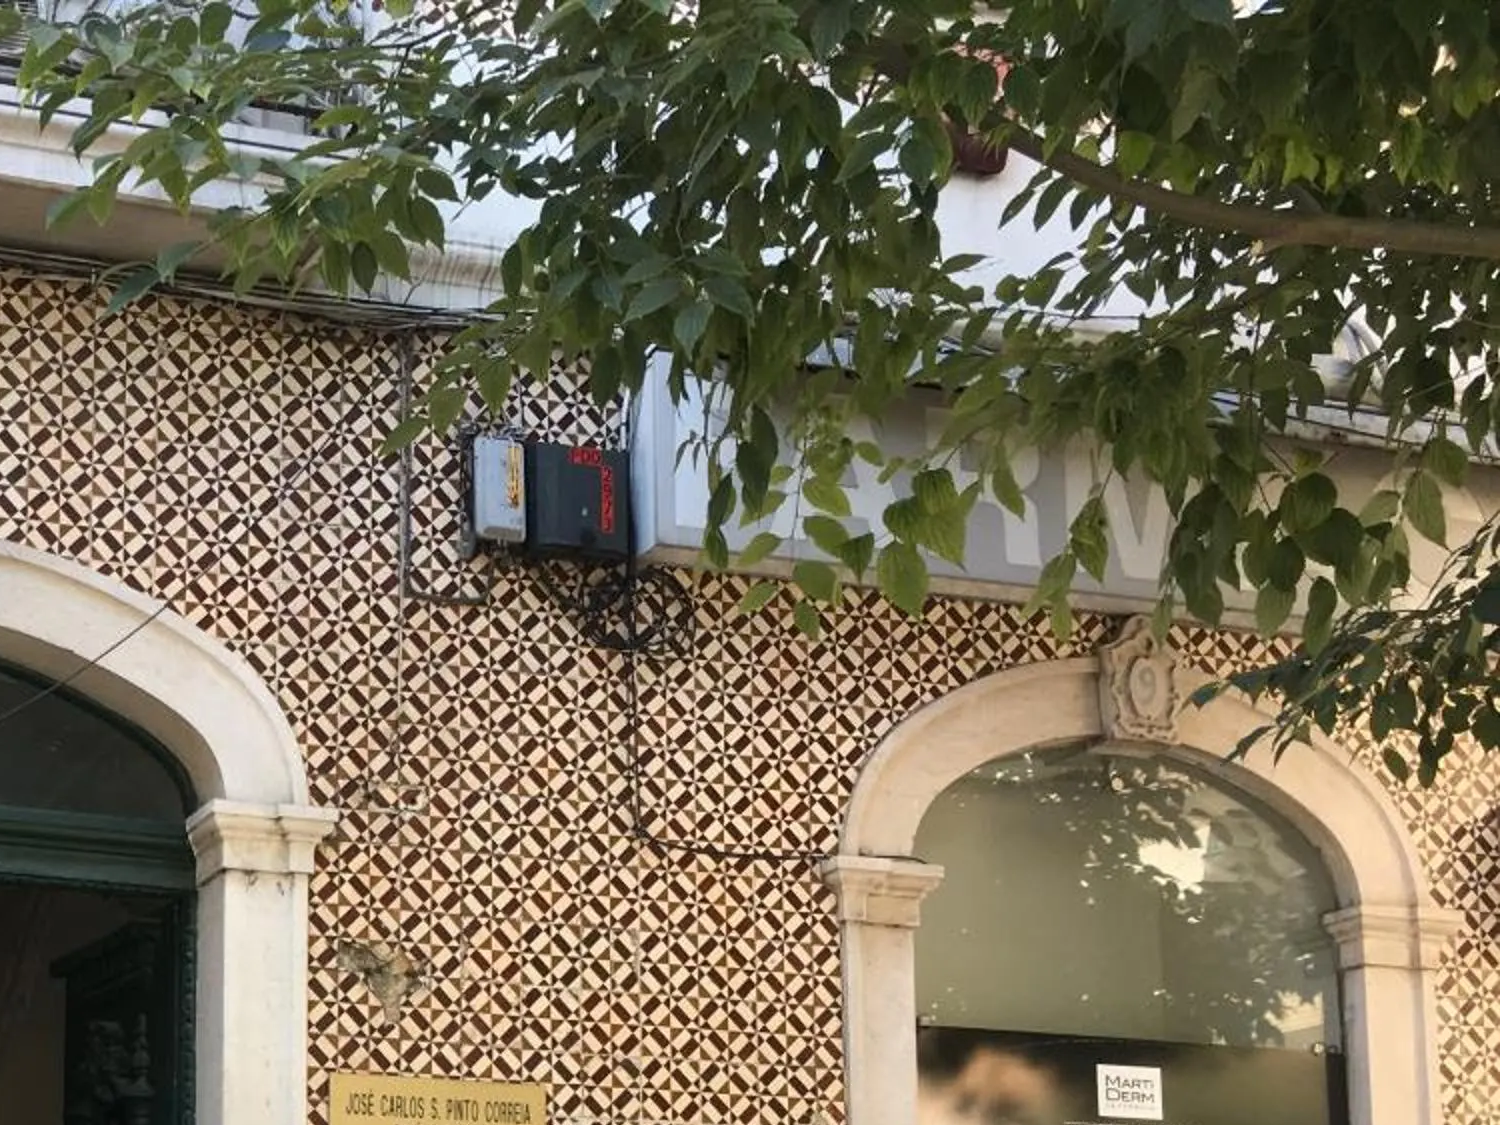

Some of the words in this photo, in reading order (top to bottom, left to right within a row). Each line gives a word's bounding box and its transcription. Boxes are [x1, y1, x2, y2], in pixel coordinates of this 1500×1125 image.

[345, 1089, 375, 1117] JOSÉ
[381, 1094, 425, 1120] CARLOS
[446, 1099, 479, 1123] PINTO
[485, 1101, 532, 1125] CORREIA
